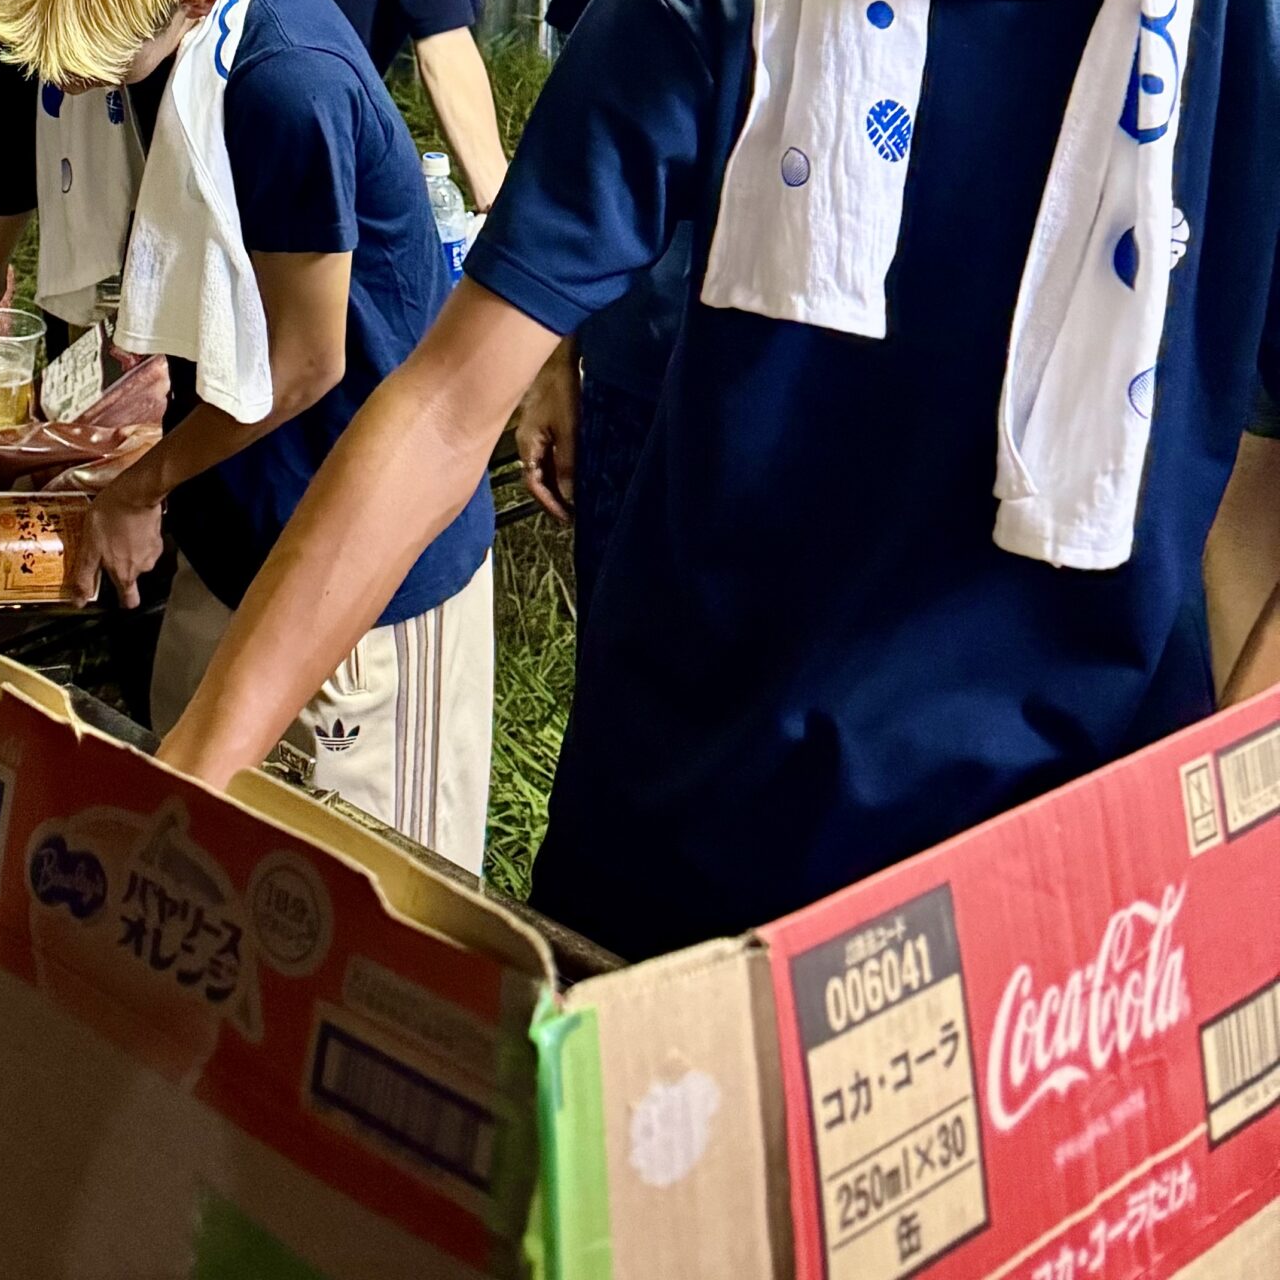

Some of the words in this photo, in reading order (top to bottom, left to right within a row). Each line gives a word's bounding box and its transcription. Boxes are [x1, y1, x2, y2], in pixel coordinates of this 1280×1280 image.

[118, 915, 238, 1001] オレンジ
[122, 871, 242, 963] バヤリース
[825, 933, 932, 1031] 006041
[822, 1019, 960, 1131] コカ・コーラ
[896, 1211, 923, 1263] 缶
